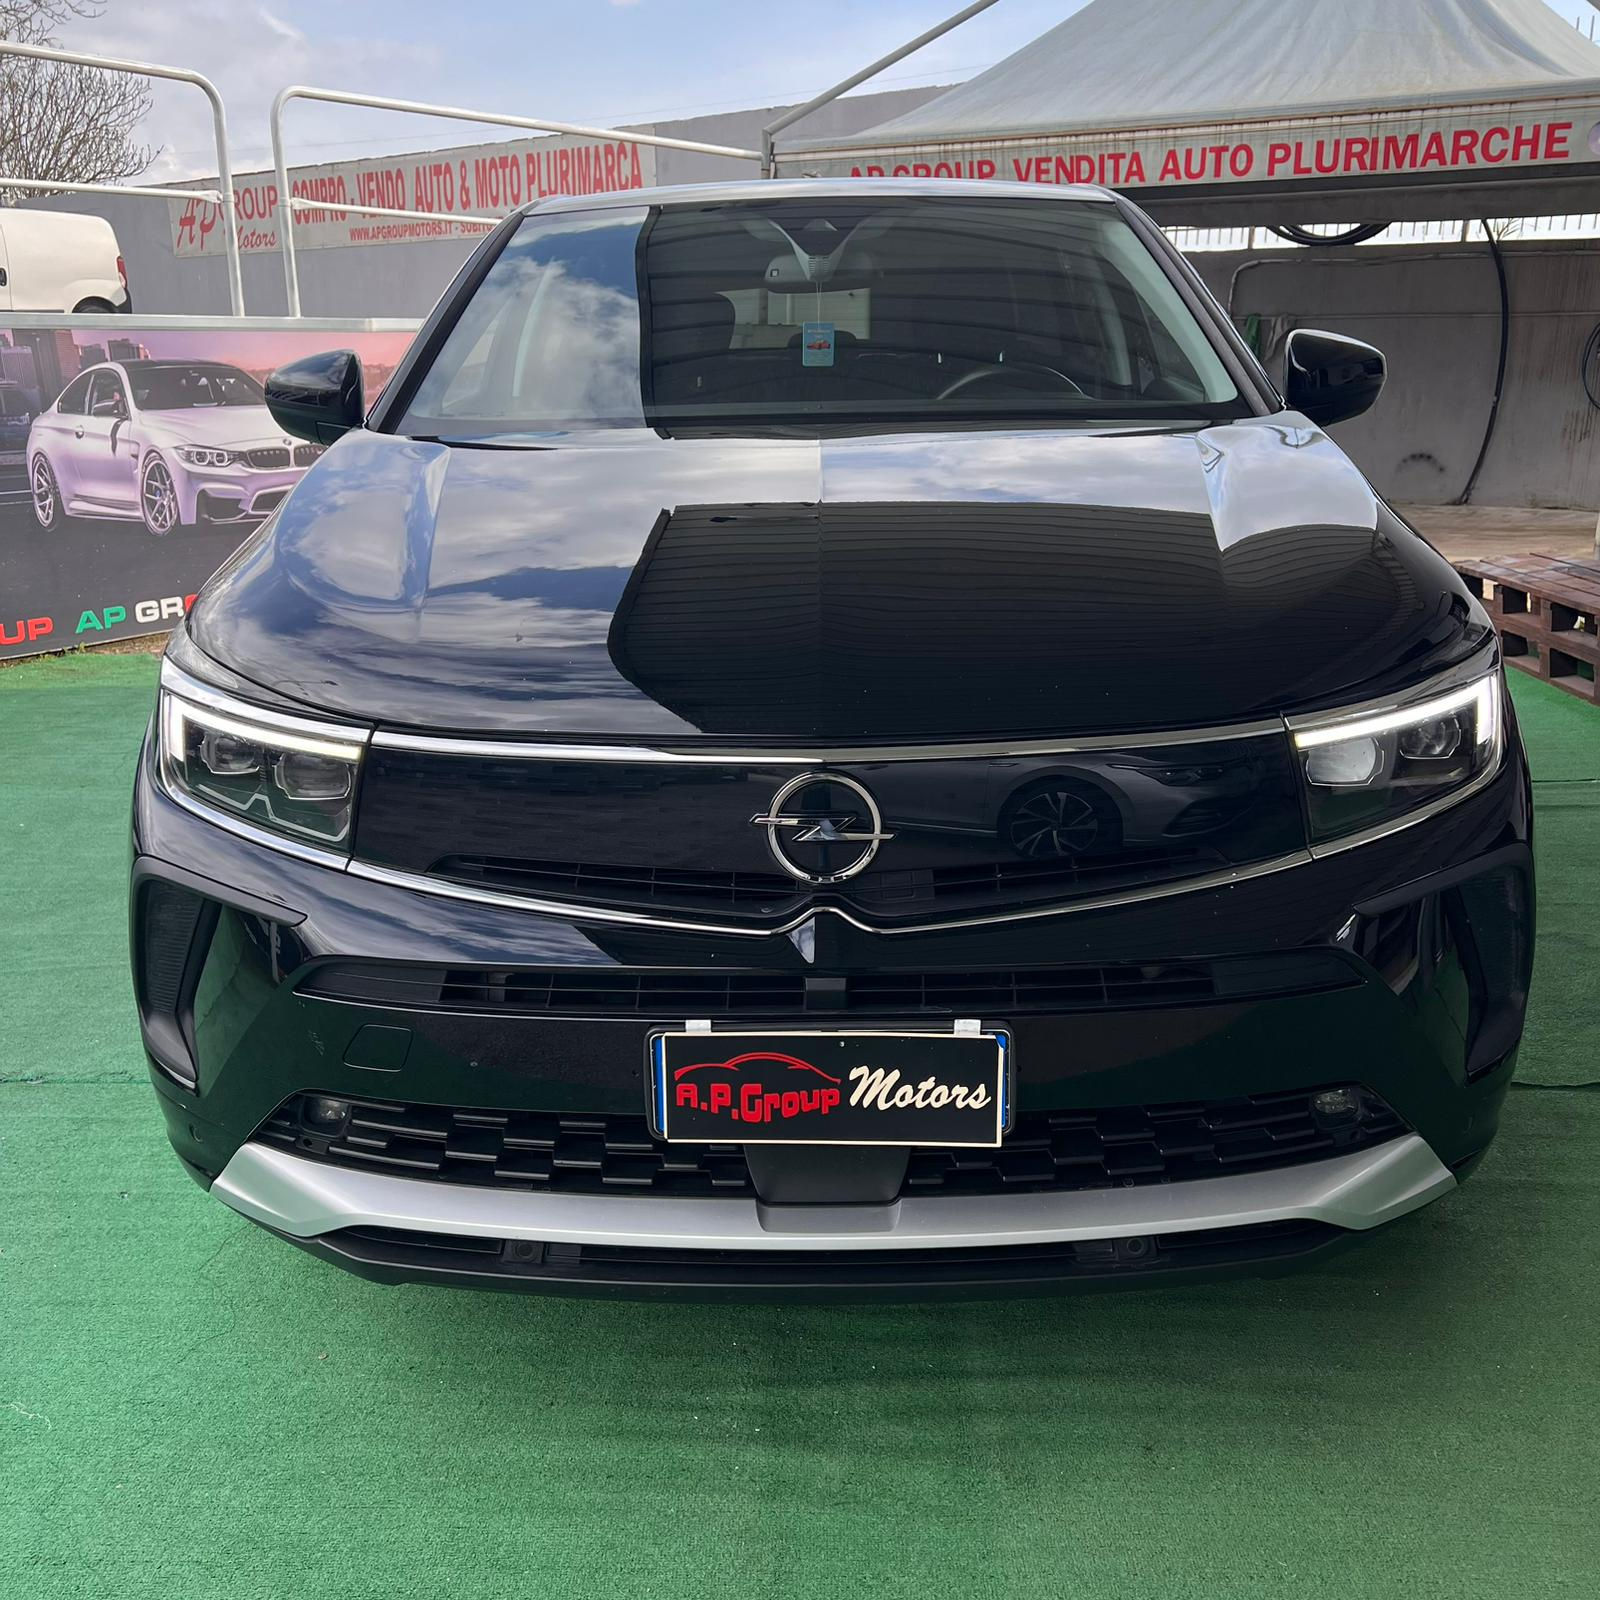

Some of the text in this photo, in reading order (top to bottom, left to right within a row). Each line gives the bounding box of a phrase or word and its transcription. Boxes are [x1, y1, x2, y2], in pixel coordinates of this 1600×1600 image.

[1013, 151, 1146, 184] VENDITA
[1158, 143, 1254, 181] AUTO
[1266, 122, 1573, 177] PLURIMARCHE
[292, 174, 348, 225] COMPRO
[356, 167, 406, 219] VENDO
[415, 161, 455, 213] AUTO
[459, 160, 471, 211] &
[475, 153, 522, 209] MOTO
[526, 139, 643, 203] PLURIMARCA
[218, 184, 278, 222] ROUP
[224, 225, 277, 250] otors
[349, 220, 453, 241] WWW.APGROUPMOTORS.IT
[75, 605, 127, 634] AP
[675, 1065, 992, 1123] A.P.Group Motors
